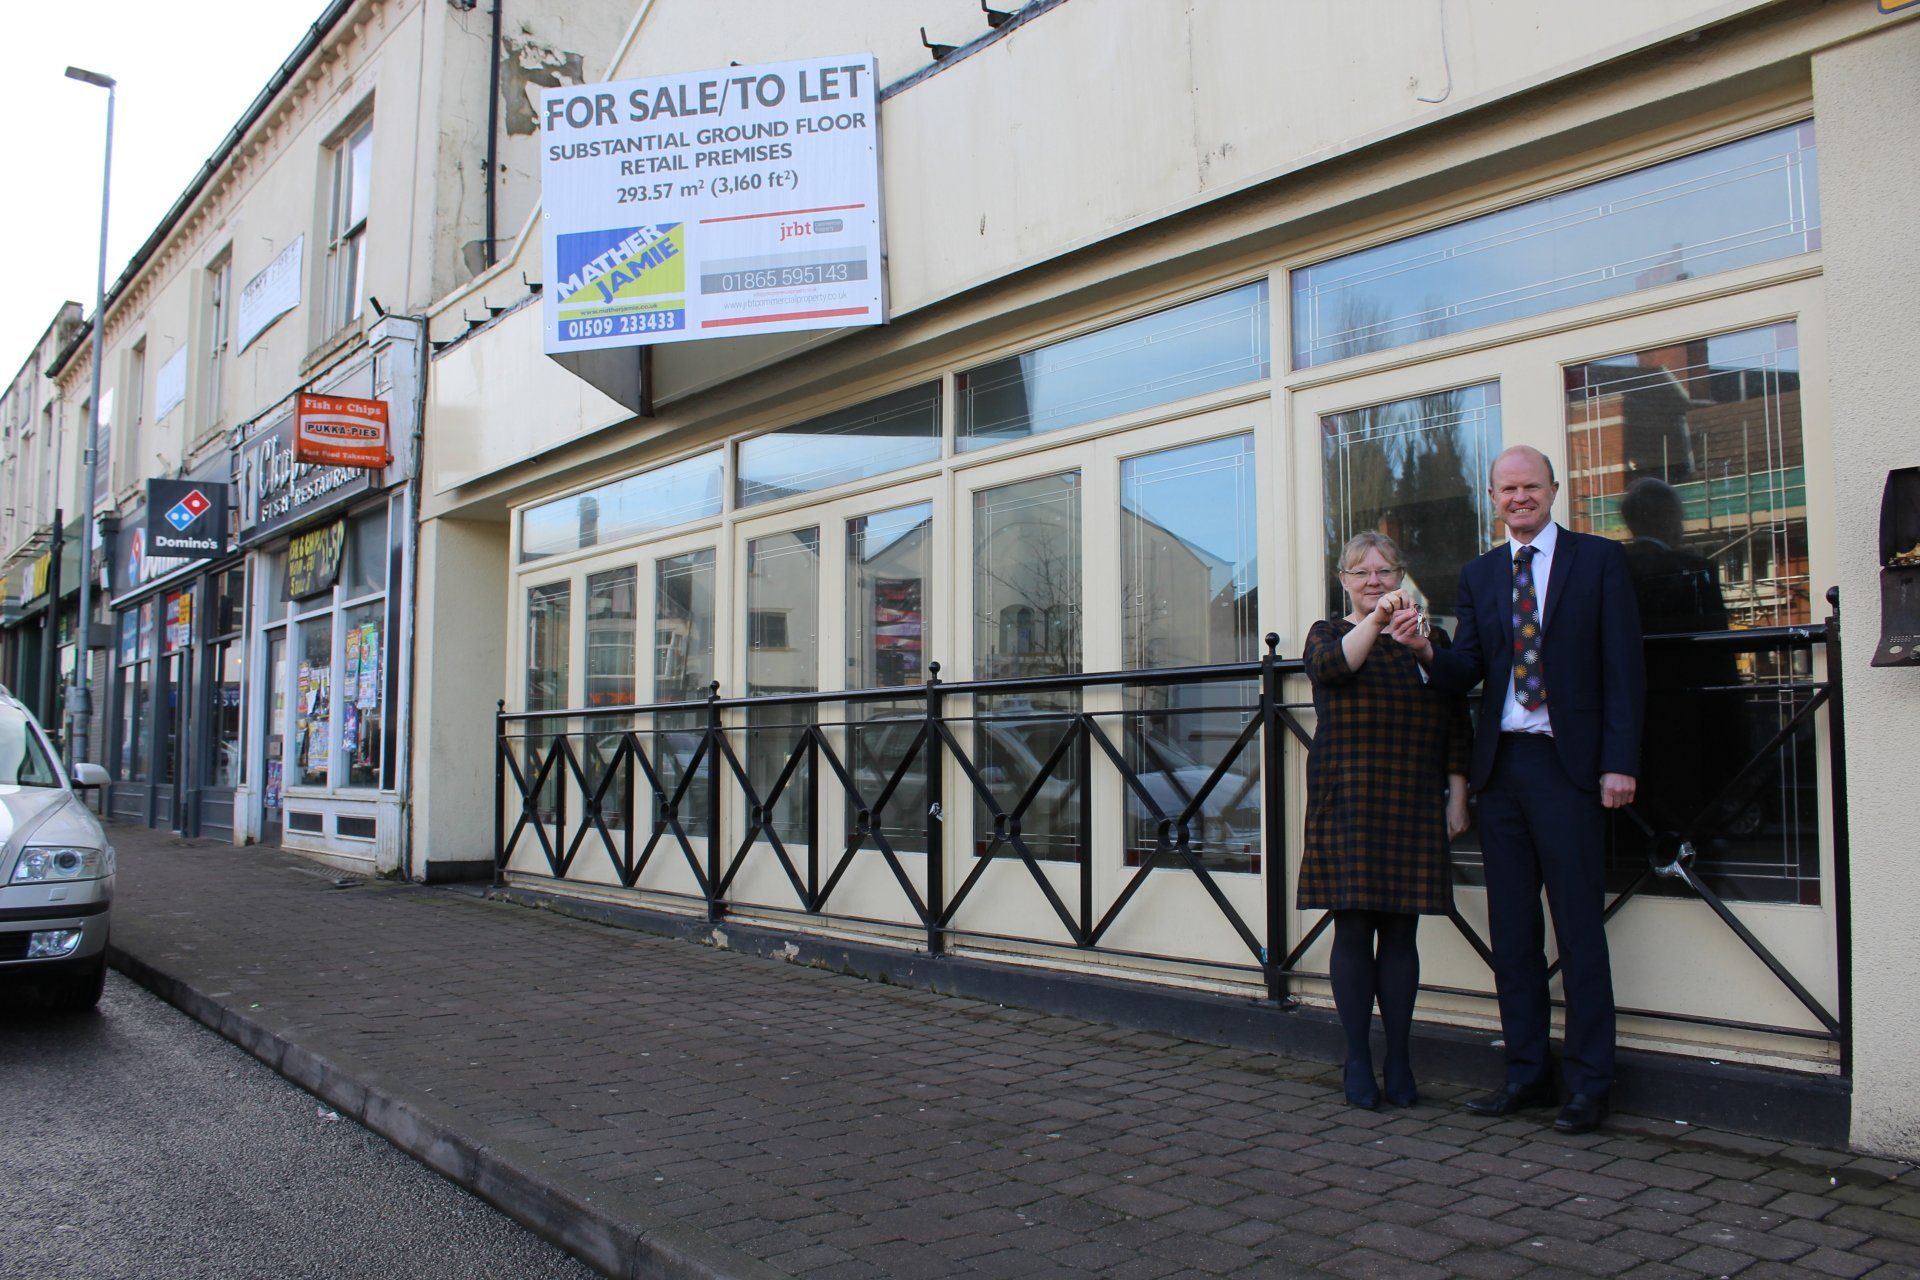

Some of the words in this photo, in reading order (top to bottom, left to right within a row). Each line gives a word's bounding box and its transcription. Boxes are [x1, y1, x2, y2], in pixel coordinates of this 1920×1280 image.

[546, 93, 618, 132] FOR
[630, 73, 785, 122] SALE/TO
[799, 64, 866, 104] LET
[549, 131, 690, 161] SUBSTANTIAL
[696, 120, 788, 145] GROUND
[796, 112, 866, 135] FLOOR
[621, 152, 689, 176] RETAIL
[695, 143, 793, 168] PREMISES
[616, 182, 673, 204] 293.57
[711, 173, 762, 199] (3,160
[780, 221, 812, 242] jrbt
[557, 224, 666, 300] MATHER
[596, 237, 680, 304] JAMIE
[722, 270, 777, 291] 01865
[782, 263, 848, 286] 595143
[568, 318, 614, 338] 01509
[620, 311, 675, 333] 233433
[304, 399, 331, 410] Fish
[347, 403, 382, 416] Chips
[155, 535, 218, 550] Domino's
